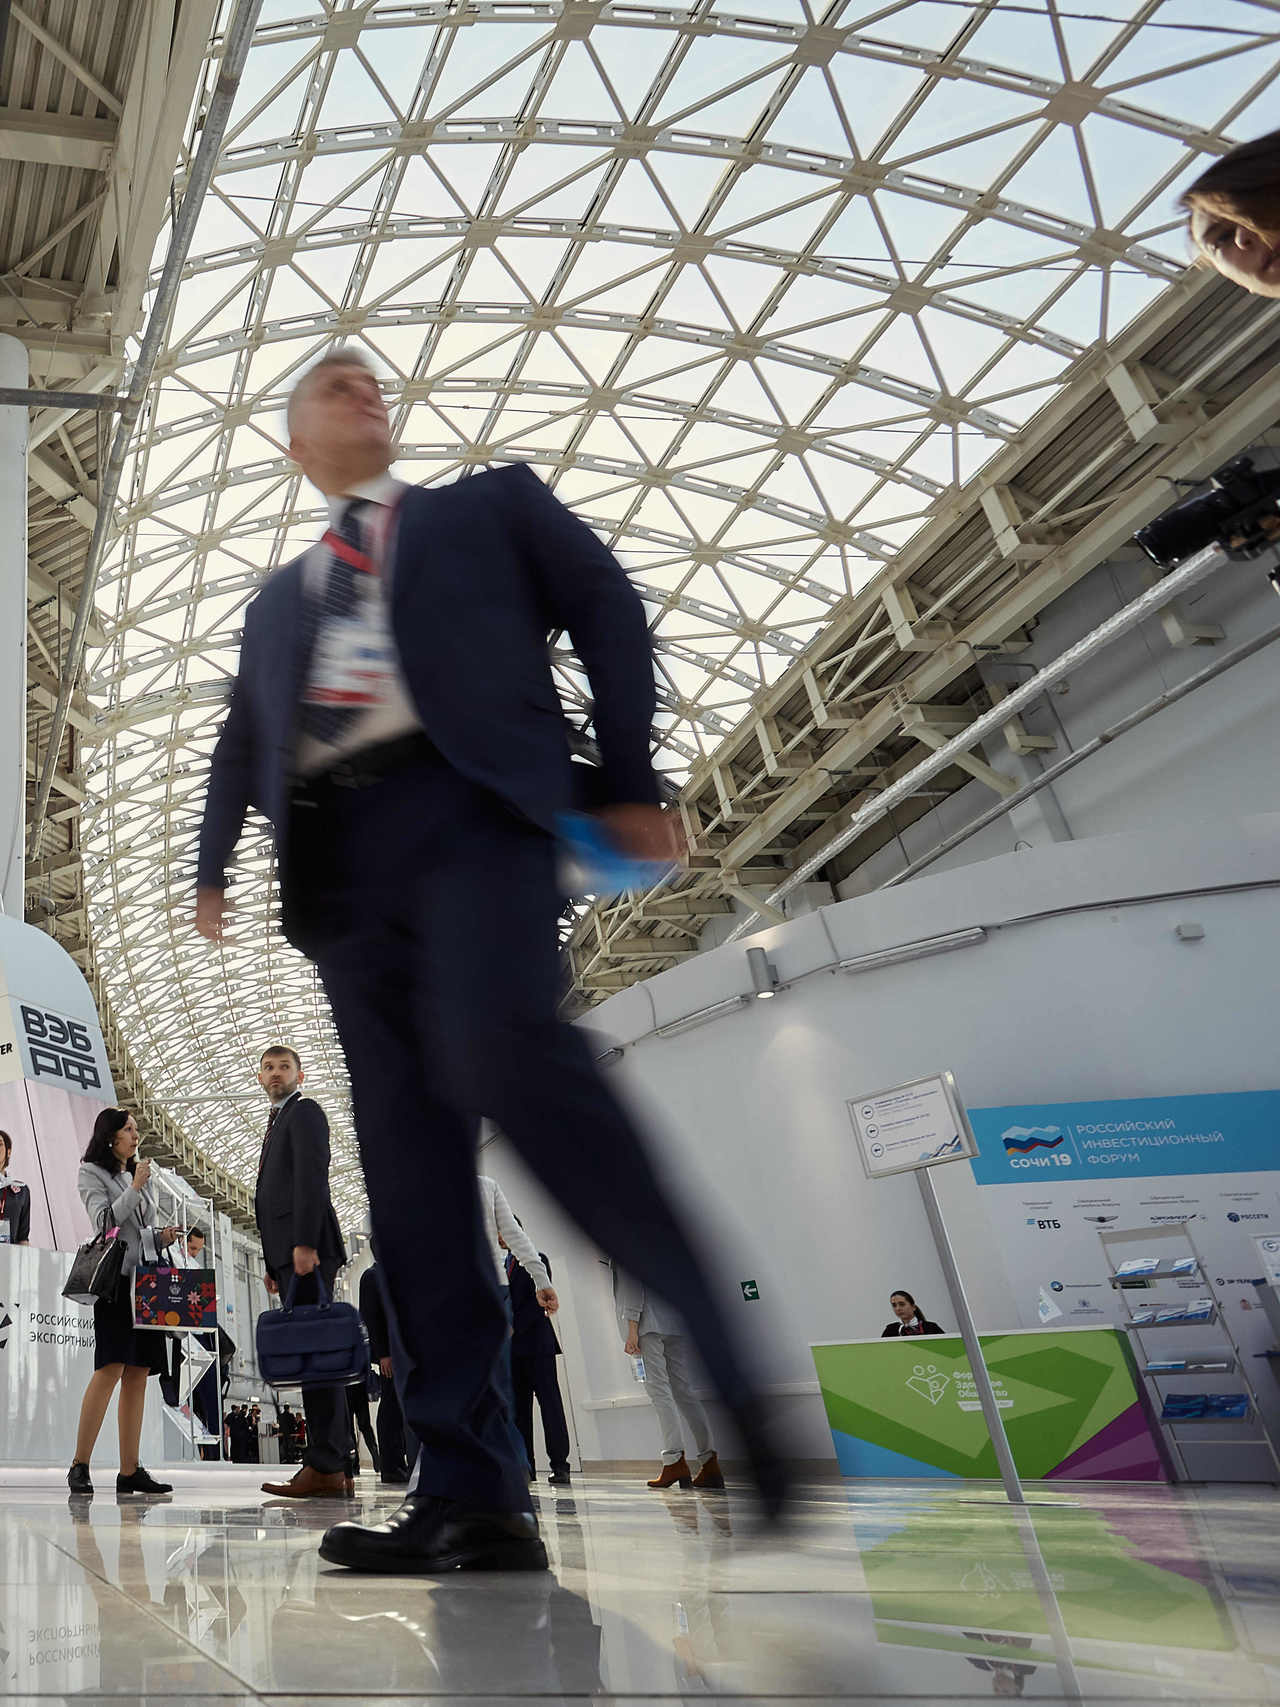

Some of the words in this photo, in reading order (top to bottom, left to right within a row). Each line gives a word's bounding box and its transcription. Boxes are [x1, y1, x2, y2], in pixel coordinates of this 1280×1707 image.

[20, 1005, 92, 1053] ВЭБ
[29, 1046, 102, 1090] РФ
[1076, 1118, 1176, 1135] РОССИЙСКИЙ
[1081, 1130, 1225, 1150] ИНВЕСТИЦИОННЫЙ
[1009, 1157, 1050, 1169] СОЧИ
[1050, 1153, 1072, 1166] 19
[1087, 1152, 1141, 1165] ФОРУМ
[1037, 1219, 1061, 1229] ВТБ
[30, 1312, 95, 1330] РОССИЙСКИЙ
[29, 1331, 95, 1348] ЭКСПОРТНЫЙ
